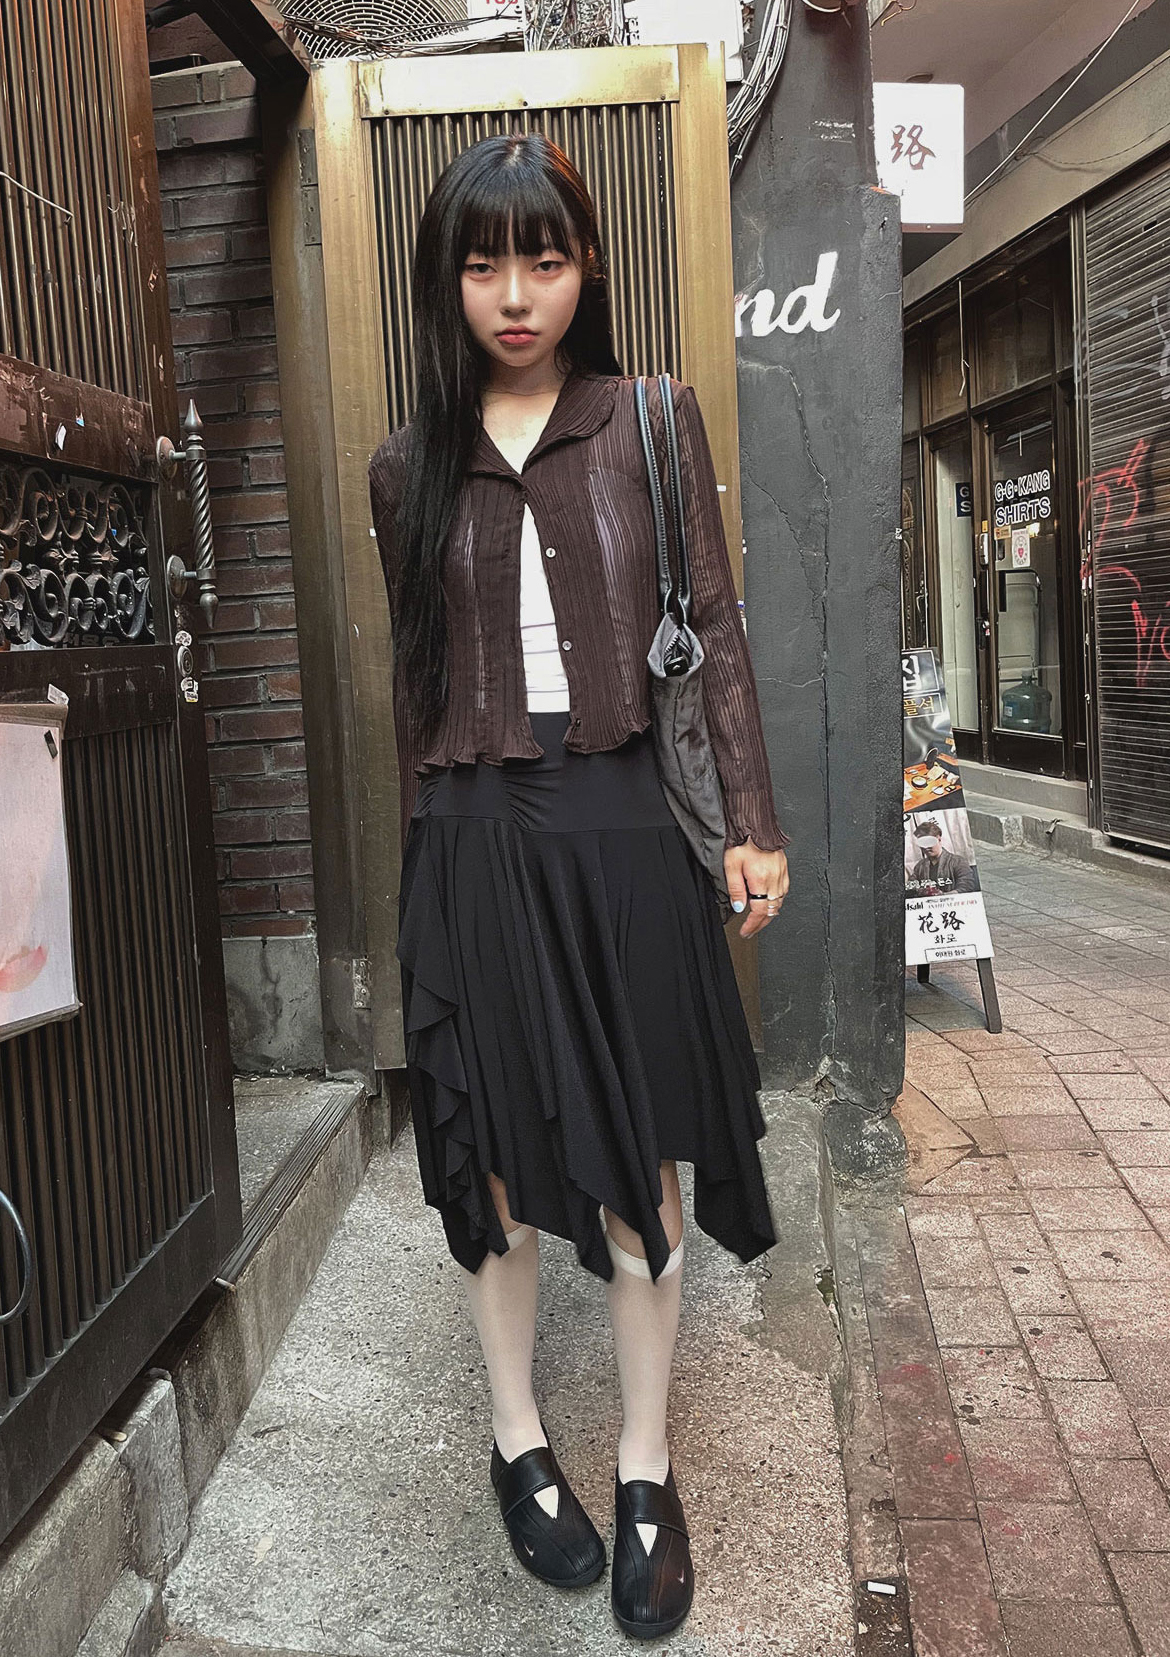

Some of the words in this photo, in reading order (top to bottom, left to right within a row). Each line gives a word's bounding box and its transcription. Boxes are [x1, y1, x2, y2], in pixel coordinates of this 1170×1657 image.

[891, 124, 937, 170] 路
[995, 496, 1051, 527] SHIRTS
[918, 910, 965, 934] 花路
[934, 933, 958, 944] 화로
